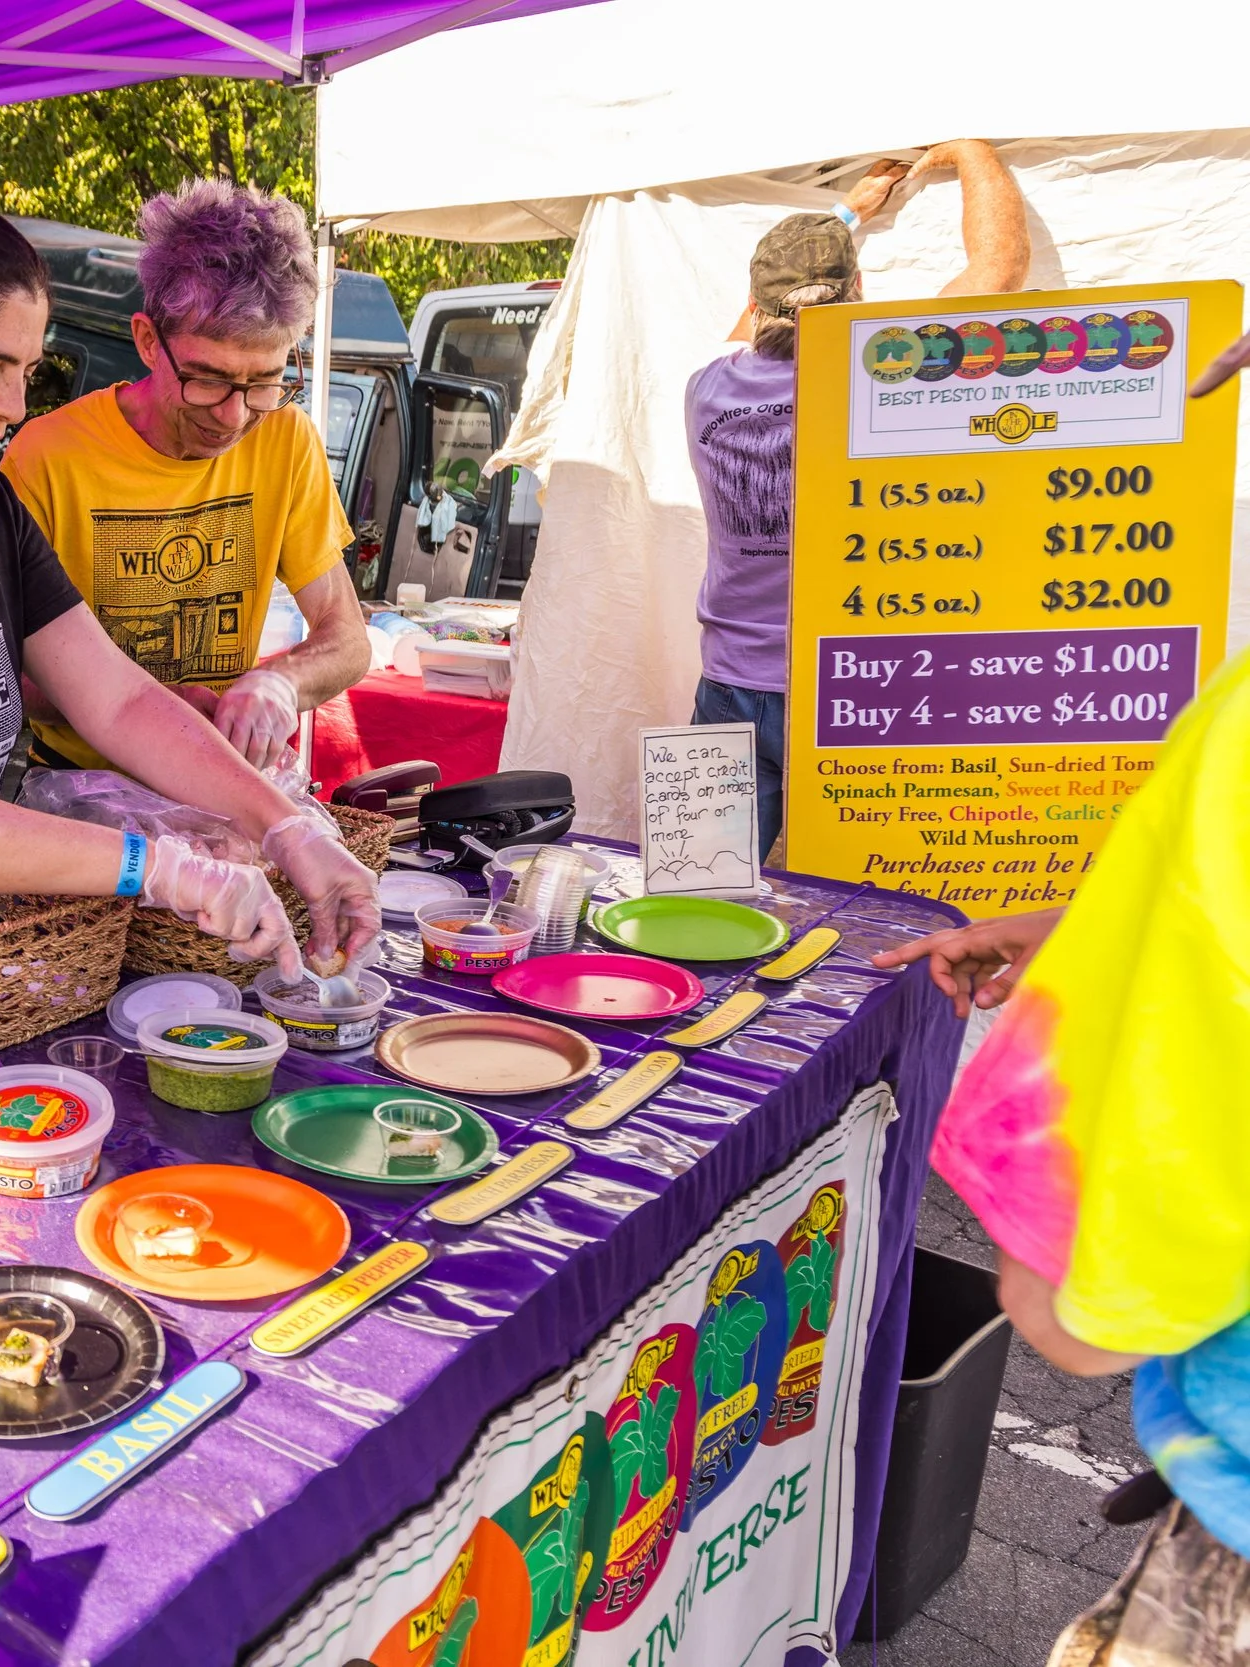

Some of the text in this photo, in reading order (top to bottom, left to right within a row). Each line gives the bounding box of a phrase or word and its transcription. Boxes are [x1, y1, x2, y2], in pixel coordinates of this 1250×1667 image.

[492, 306, 540, 324] Need
[873, 367, 913, 381] PESTO
[878, 376, 1156, 407] BEST PESTO IN THE UNIVERSE!
[699, 406, 752, 446] Willowtree
[972, 408, 1057, 439] WHOLE
[848, 465, 1154, 510] 1 (5.5 oz.) $9.00
[173, 525, 191, 534] THE
[175, 540, 189, 553] IN
[844, 520, 1175, 565] 2 (5.5 oz.) $17.00
[119, 534, 235, 583] WHOLE
[168, 550, 194, 565] THE
[166, 560, 198, 579] WALL
[156, 572, 208, 593] RESTAURANT
[842, 577, 1172, 618] 4 (5.5 oz.) $32.00
[831, 650, 902, 687] Buy
[911, 650, 934, 677] 2
[969, 655, 1044, 677] save
[1054, 642, 1171, 678] $1.00!
[830, 699, 901, 735] Buy
[910, 696, 933, 726] 4
[968, 704, 1042, 725] save
[1052, 692, 1169, 729] $4.00!
[648, 746, 729, 763] We can
[645, 759, 748, 791] accept credit
[817, 759, 887, 776] Choose
[892, 758, 945, 774] from:
[950, 757, 1003, 781] Basil,
[1009, 756, 1107, 773] Sun-dried
[645, 779, 756, 803] cards on orders
[822, 780, 1105, 803] Spinach Parmesan, Sweet Red
[648, 804, 736, 825] of four or
[838, 804, 1106, 826] Dairy Free, Chipotle, Garlic
[651, 828, 694, 842] more
[919, 829, 1079, 846] Wild Mushroom
[127, 838, 140, 873] VENDOR
[862, 852, 1075, 874] Purchases can be
[937, 880, 998, 901] later
[465, 957, 511, 968] PESTO
[286, 1026, 335, 1041] PESTO
[44, 1100, 81, 1138] PESTO
[444, 1146, 561, 1218] SPINACH PARMESAN
[263, 1248, 417, 1347] SWEET RED PEPPER
[777, 1382, 790, 1396] ALL
[713, 1391, 749, 1427] FREE
[75, 1390, 215, 1486] BASIL
[606, 1564, 624, 1578] ALL
